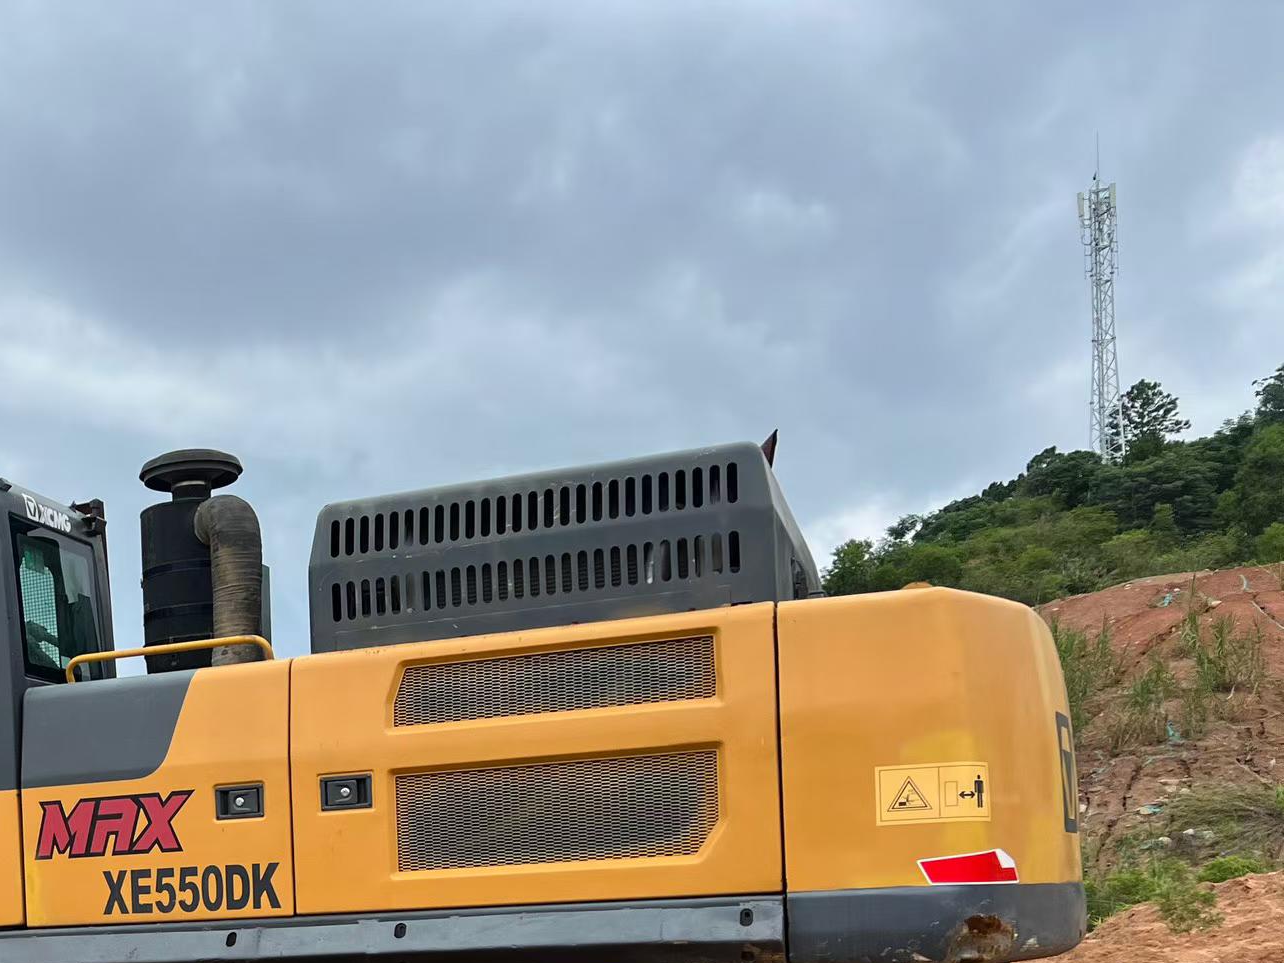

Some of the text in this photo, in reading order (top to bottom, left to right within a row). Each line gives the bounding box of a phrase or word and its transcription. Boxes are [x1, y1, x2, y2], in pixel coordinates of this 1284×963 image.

[38, 504, 72, 533] XCMG
[34, 789, 195, 861] MAX
[103, 862, 282, 915] XE550DK
